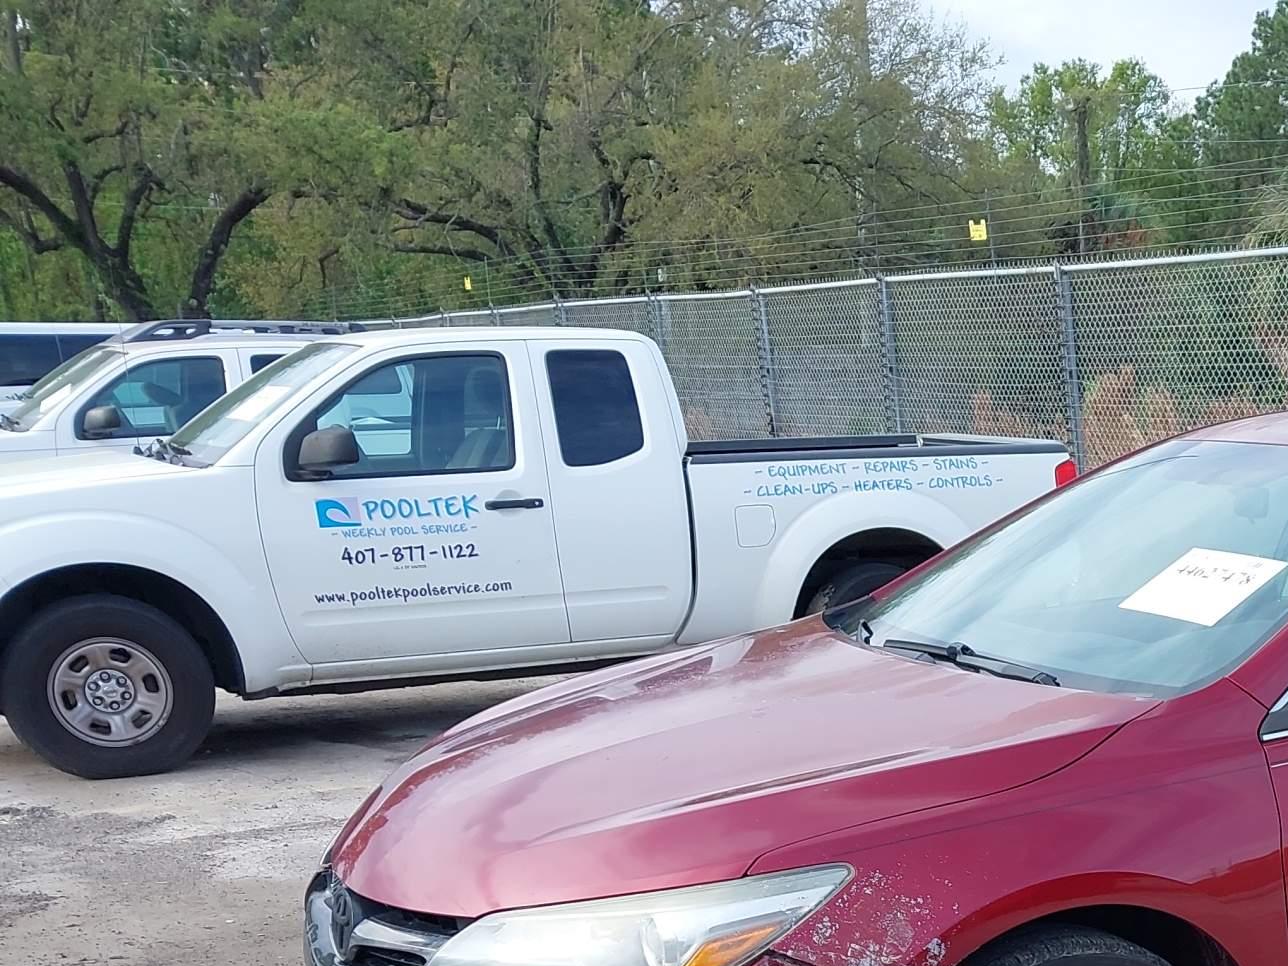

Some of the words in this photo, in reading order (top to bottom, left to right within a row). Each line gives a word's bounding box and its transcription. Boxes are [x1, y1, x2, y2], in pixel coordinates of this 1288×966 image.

[767, 462, 846, 480] EQUIPMENT
[863, 458, 917, 474] REPAIRS
[933, 456, 977, 470] STAINS
[757, 481, 837, 496] CLEAN-UPS
[854, 478, 912, 491] HEATERS
[929, 475, 992, 488] CONTROLS
[363, 495, 479, 520] POOLTEK
[341, 526, 385, 538] WEEKLY
[390, 527, 418, 536] POOL
[421, 523, 468, 535] SERVICE
[342, 544, 479, 565] 407-877-1122
[315, 582, 512, 606] www.pooltekpoolservice.com
